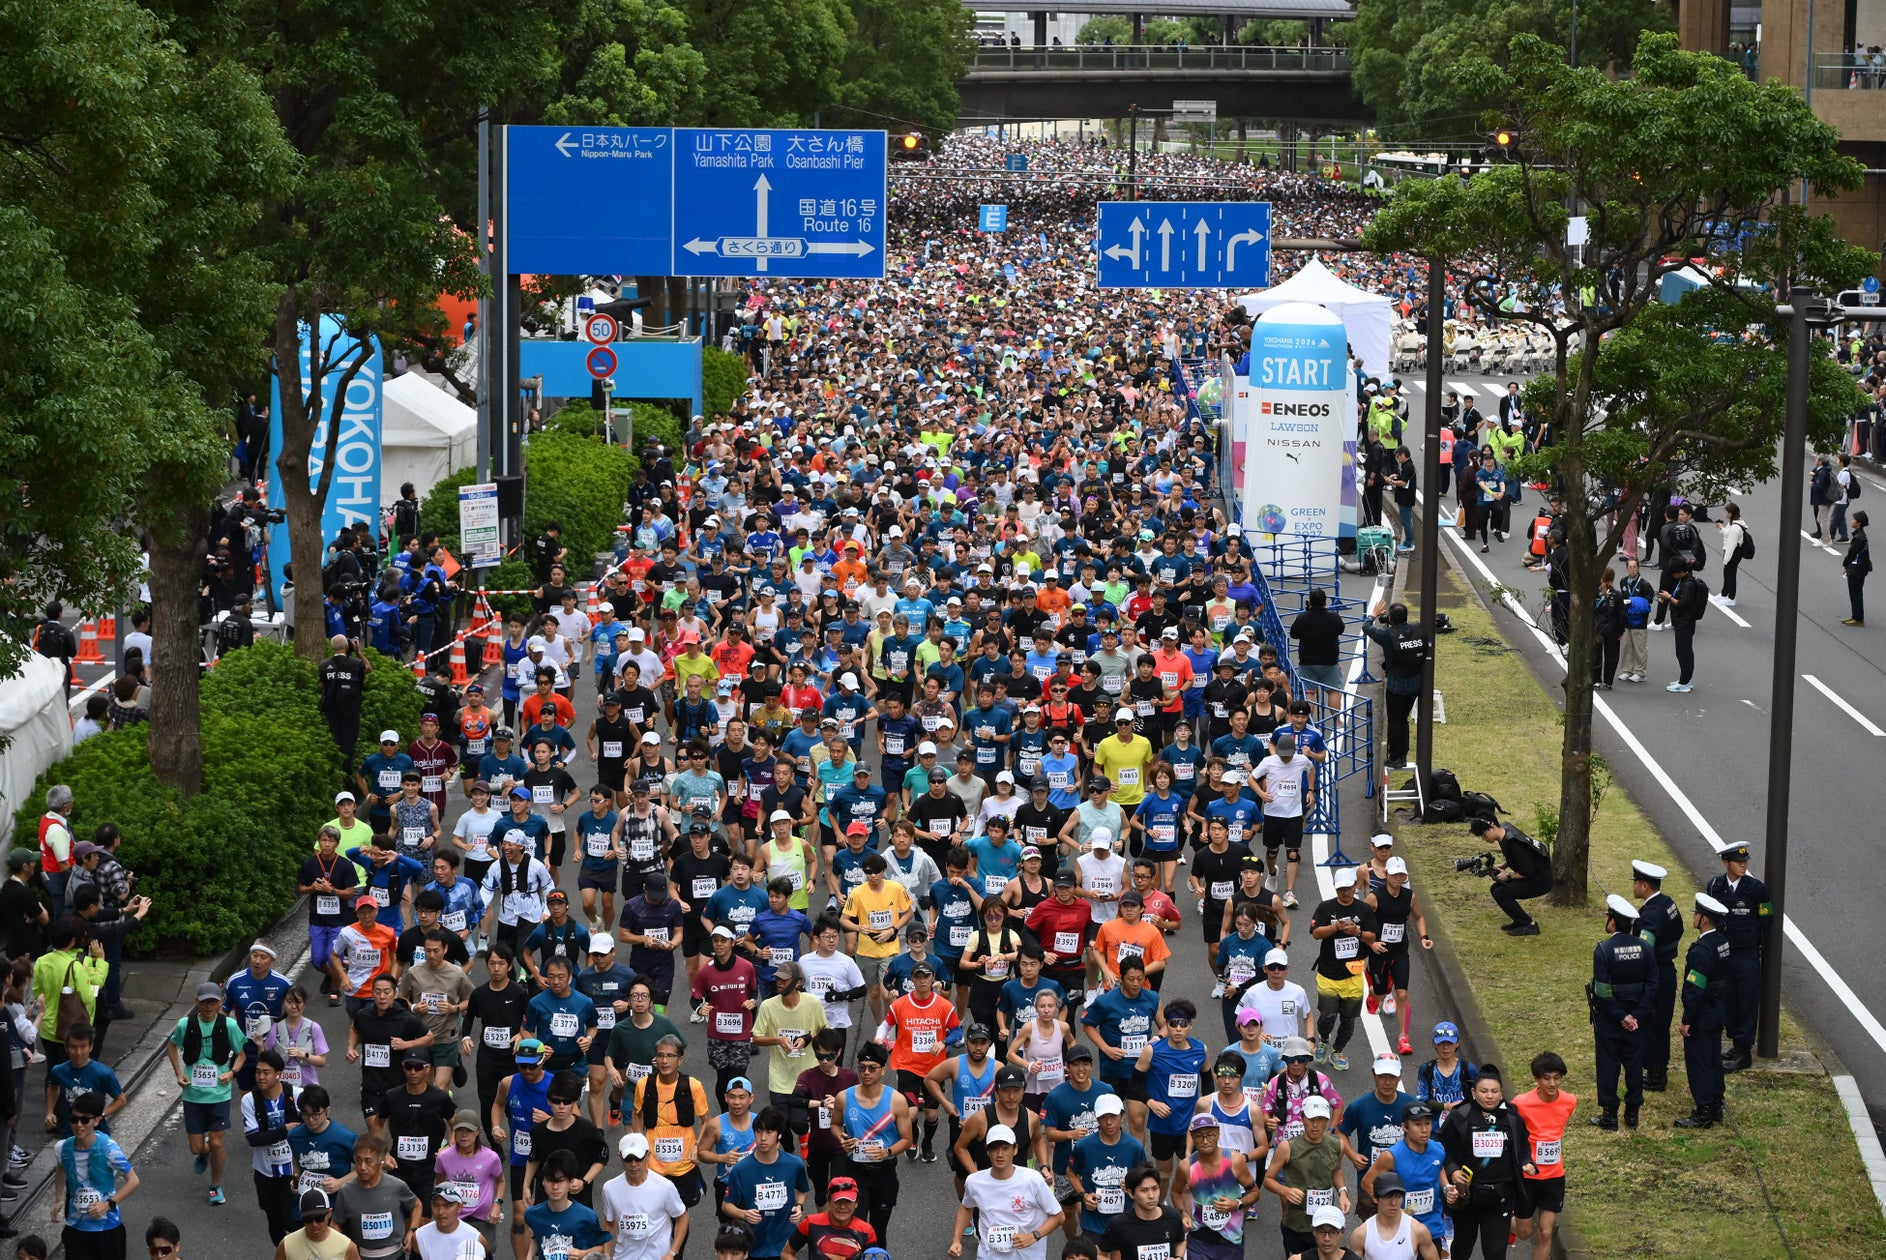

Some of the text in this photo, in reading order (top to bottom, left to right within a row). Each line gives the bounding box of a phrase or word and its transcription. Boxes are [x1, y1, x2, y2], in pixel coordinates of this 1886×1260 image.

[582, 133, 667, 148] 日本丸パーク
[696, 134, 864, 153] 山下公園 大さん橋
[581, 150, 652, 160] Nippon-Maru Park
[693, 153, 864, 169] Yamashita Park Osanbashi Pier
[799, 198, 877, 217] 国道16号
[986, 212, 1000, 227] E
[804, 218, 872, 232] Route 16
[728, 240, 796, 254] さくら通り
[592, 323, 610, 338] 50
[1262, 356, 1332, 386] START
[1273, 402, 1330, 417] ENEOS
[1270, 422, 1319, 432] LAWSON
[336, 354, 376, 537] YOKOHA
[1267, 438, 1321, 448] NISSAN
[1290, 508, 1326, 516] GREEN
[1294, 522, 1322, 531] EXPO
[1400, 640, 1423, 650] PRESS
[906, 1018, 941, 1026] HITACHI
[1170, 1079, 1196, 1088] B3209
[515, 1136, 532, 1146] B495
[400, 1144, 426, 1152] B3130
[656, 1144, 682, 1153] B5354
[300, 1178, 320, 1188] B406
[461, 1190, 478, 1198] 0176
[758, 1190, 785, 1200] B477
[1098, 1195, 1123, 1204] B4671
[1308, 1197, 1332, 1205] B422
[363, 1218, 392, 1229] B50111
[620, 1220, 647, 1230] B5975
